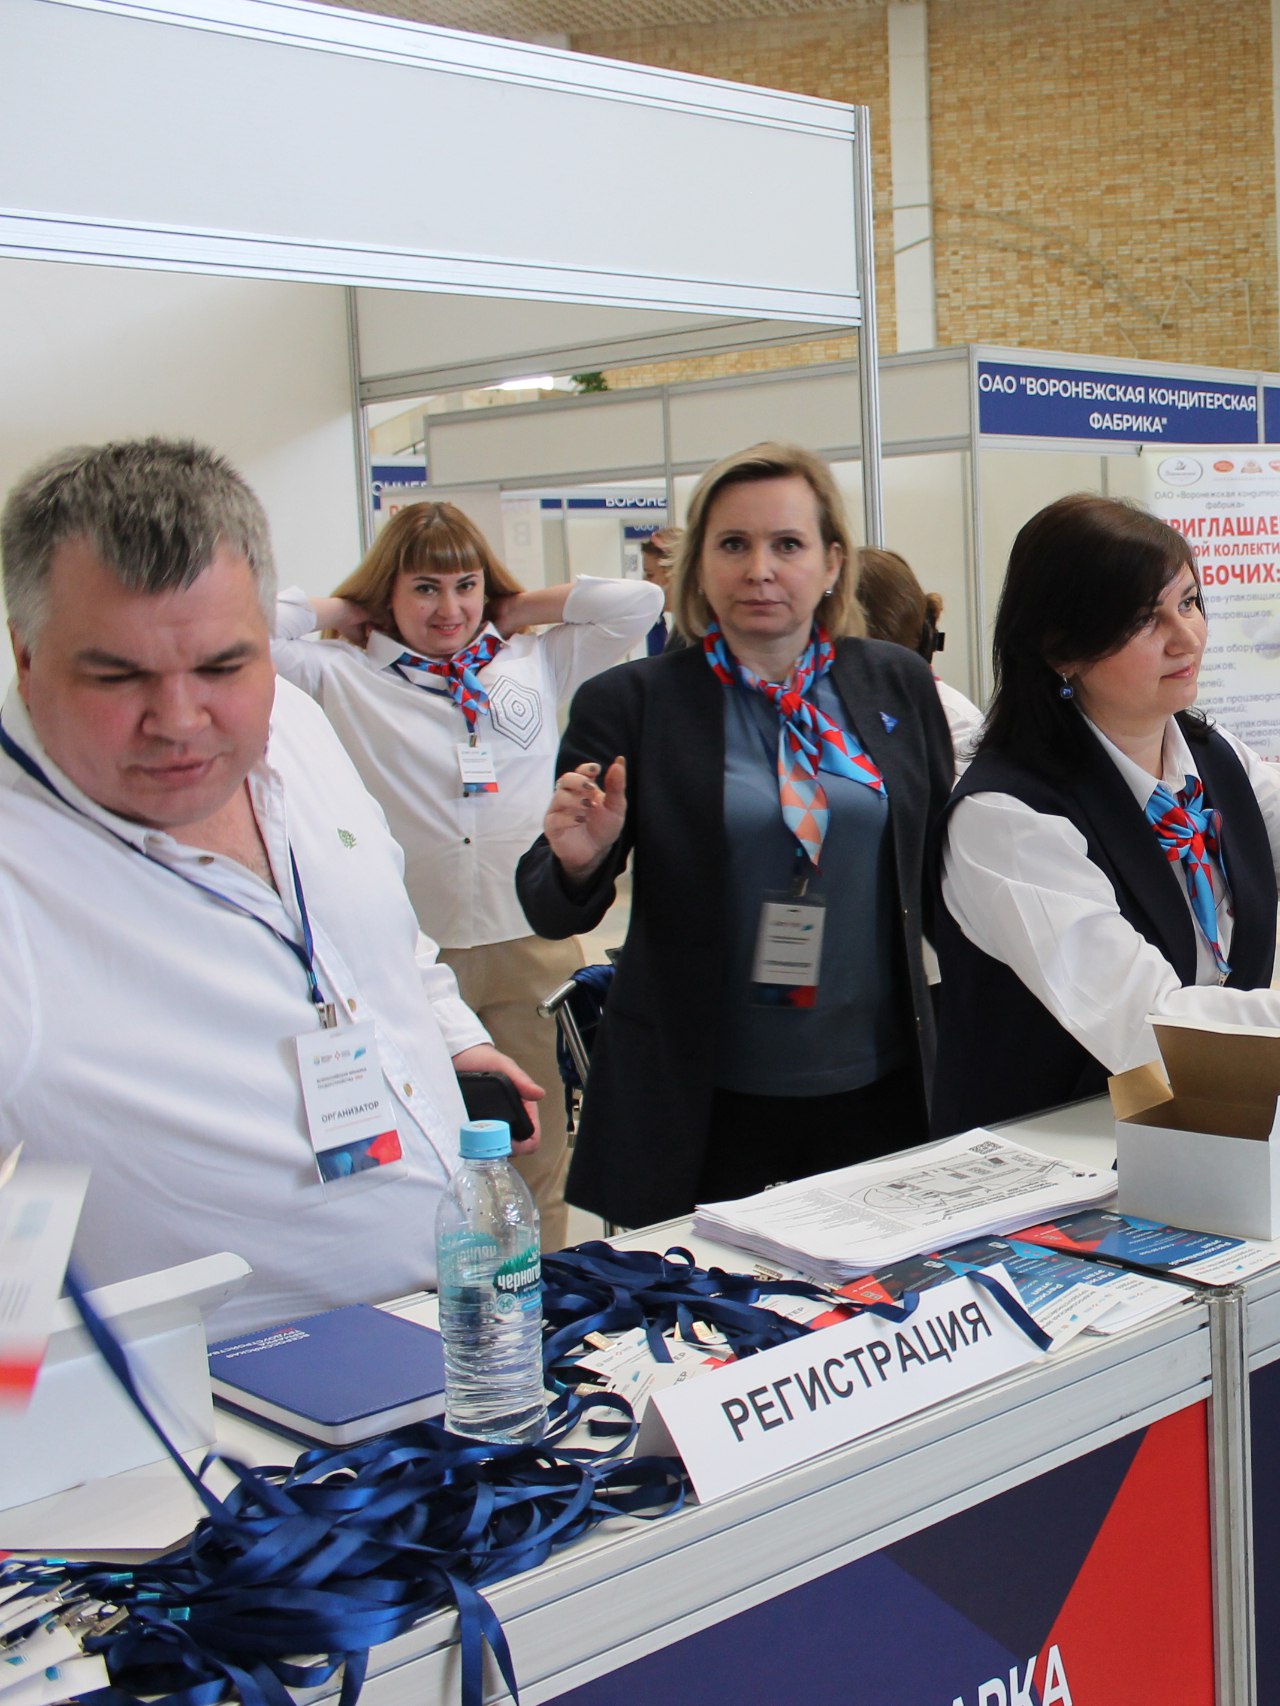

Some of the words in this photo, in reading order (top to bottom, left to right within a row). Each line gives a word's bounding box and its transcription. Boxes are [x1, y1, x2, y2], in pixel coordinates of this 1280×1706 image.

[979, 374, 1016, 394] ОАО
[1020, 378, 1145, 403] "ВОРОНЕЖСКАЯ
[1149, 389, 1256, 411] КОНДИТЕРСКАЯ
[1089, 412, 1167, 433] ФАБРИКА"
[605, 497, 667, 507] ВОРОНЕ
[1193, 541, 1210, 557] ОЙ
[1202, 563, 1280, 586] БОЧИХ:
[321, 1101, 380, 1124] ОРГАНИЗАТОР
[787, 1306, 805, 1317] ТЕР
[721, 1301, 993, 1443] РЕГИСТРАЦИЯ
